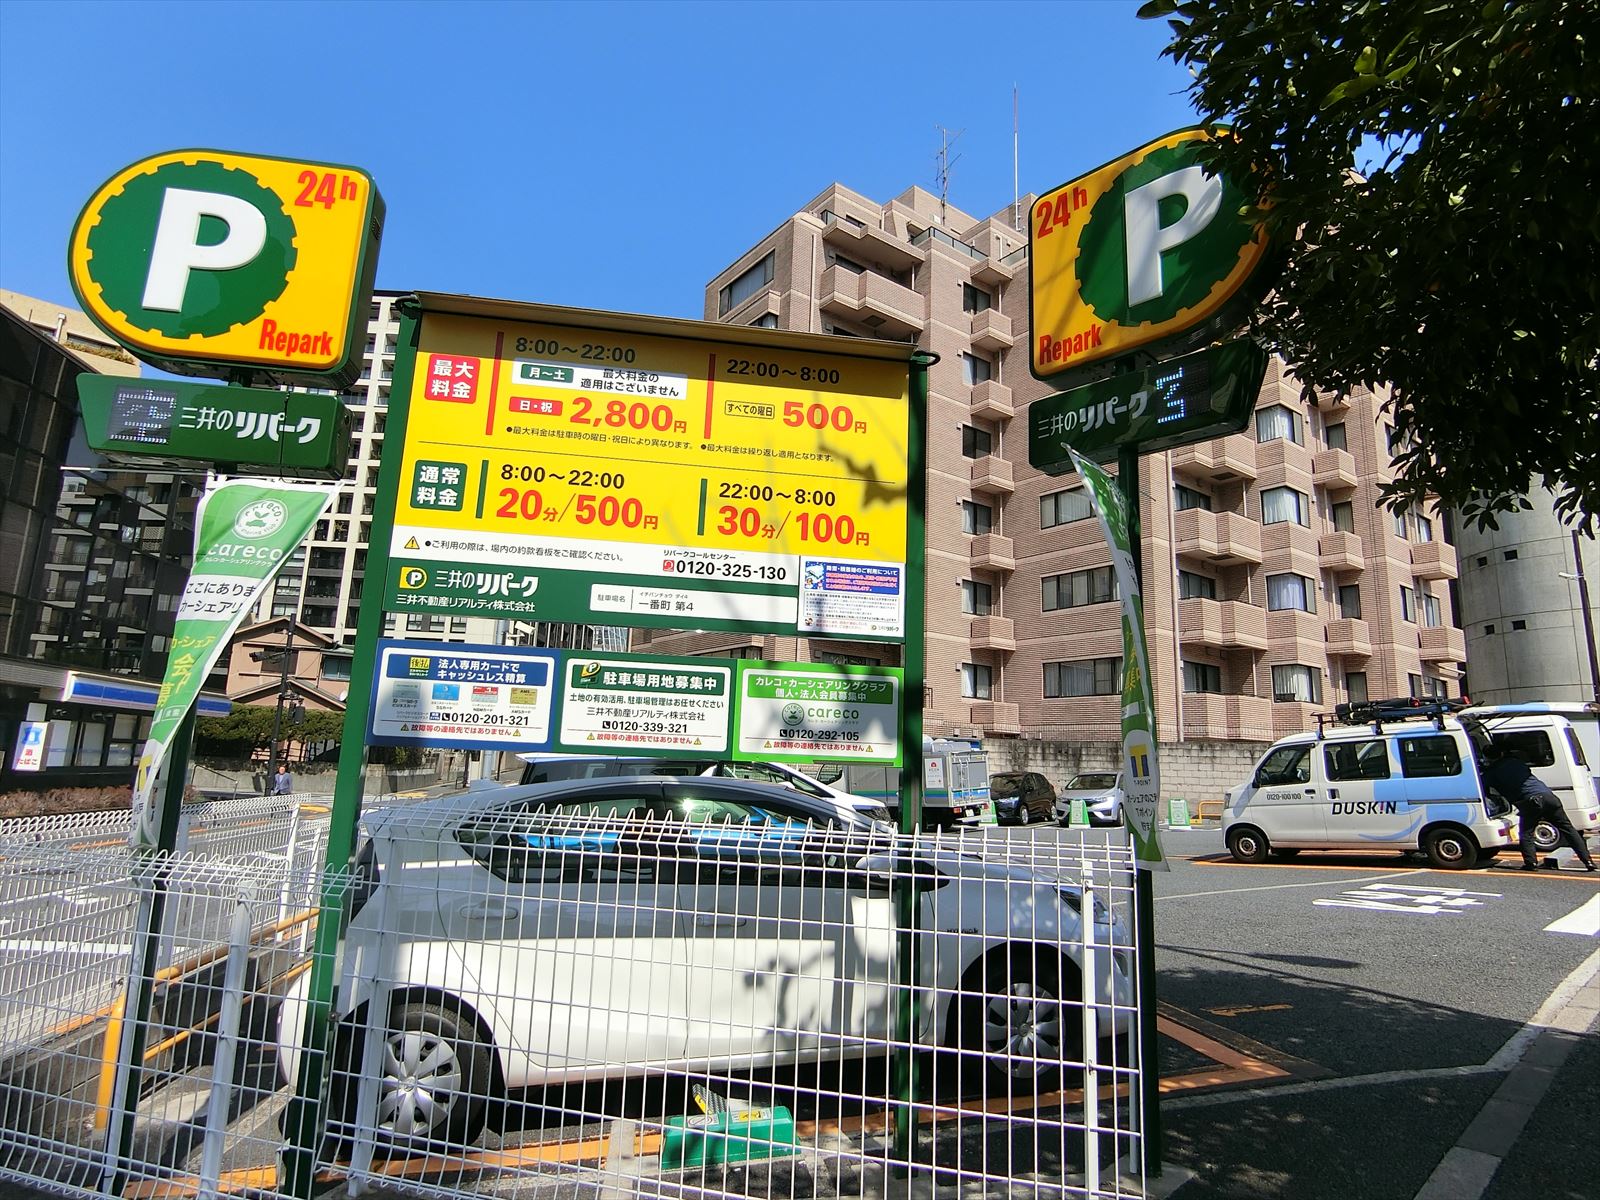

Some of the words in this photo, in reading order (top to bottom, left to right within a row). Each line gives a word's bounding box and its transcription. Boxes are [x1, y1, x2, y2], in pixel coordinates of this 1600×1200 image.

[1124, 166, 1223, 307] P
[142, 187, 267, 313] P
[259, 318, 333, 357] Repark
[1039, 324, 1102, 365] Repark
[433, 359, 475, 379] 最大
[602, 368, 660, 383] 最大料金の
[431, 379, 472, 399] 料金
[727, 402, 774, 417] すべての曜日
[1037, 391, 1148, 439] 三井のリパーク
[179, 406, 321, 445] 三井のリパーク
[419, 464, 461, 486] 通常
[417, 486, 459, 507] 料金
[676, 560, 787, 581] 0120-325-130
[434, 569, 540, 598] 三井のリパーク
[396, 593, 536, 613] 三井不動産リアルティ株式会社
[638, 599, 671, 611] 一番町
[674, 601, 694, 612] 第4
[438, 658, 521, 673] 法人専用カードで
[437, 669, 527, 684] キャッシュレス精算
[603, 671, 717, 691] 駐車場用地募集中
[451, 712, 529, 726] 0120-201-321
[586, 706, 706, 721] 三井不動産リアルティ株式会社
[807, 706, 859, 720] careco
[611, 721, 688, 733] 0120-339-321
[788, 729, 860, 741] 0120-292-105
